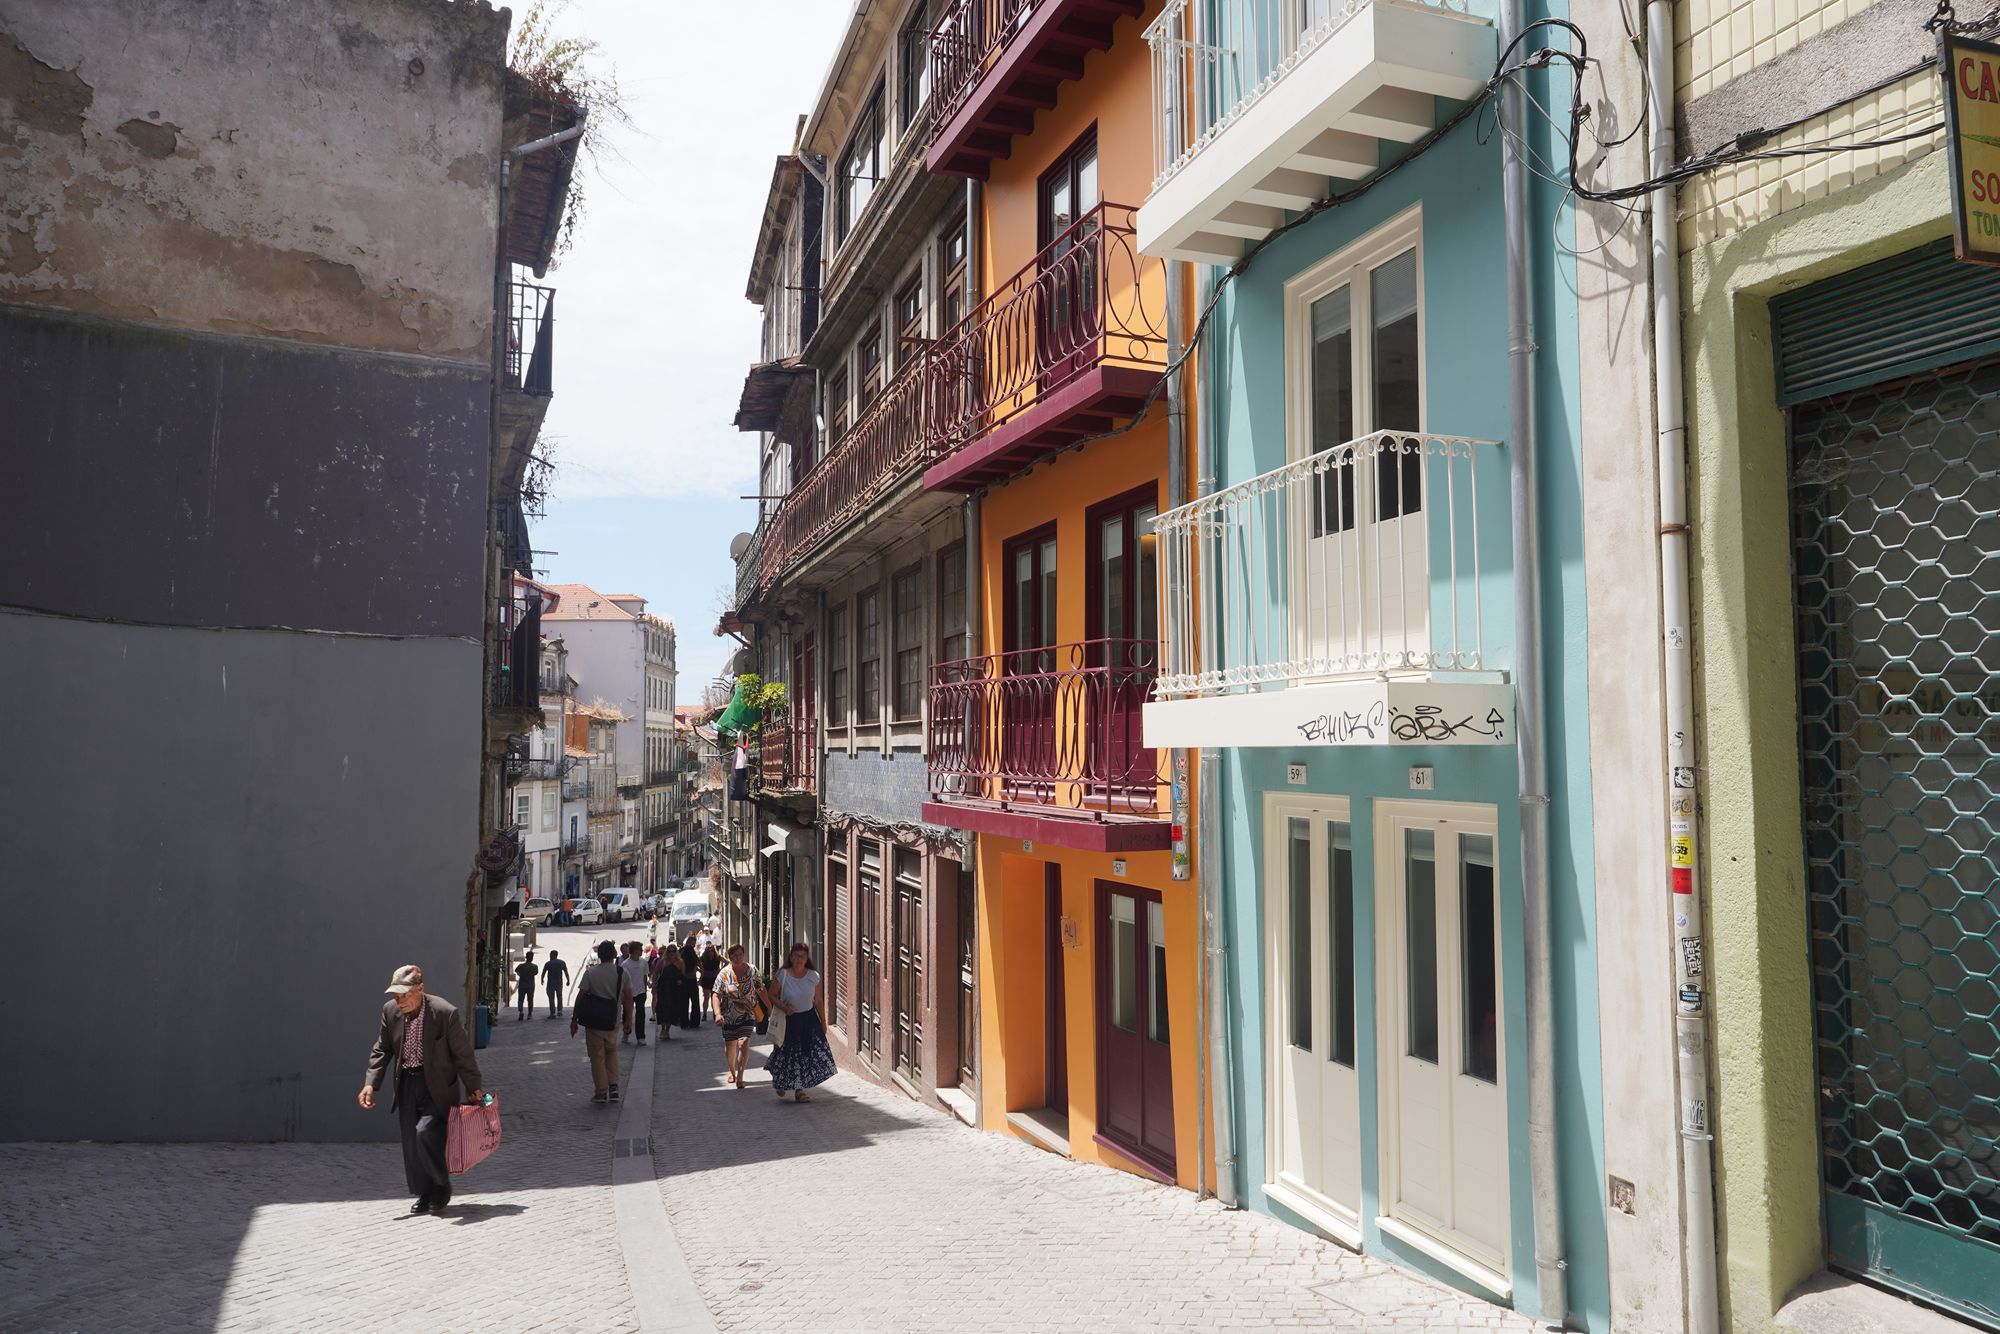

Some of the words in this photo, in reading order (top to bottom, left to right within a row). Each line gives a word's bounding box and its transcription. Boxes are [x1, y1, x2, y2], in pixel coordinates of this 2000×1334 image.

[1959, 56, 2000, 104] CA
[1290, 768, 1300, 780] 59
[1415, 771, 1425, 785] 61
